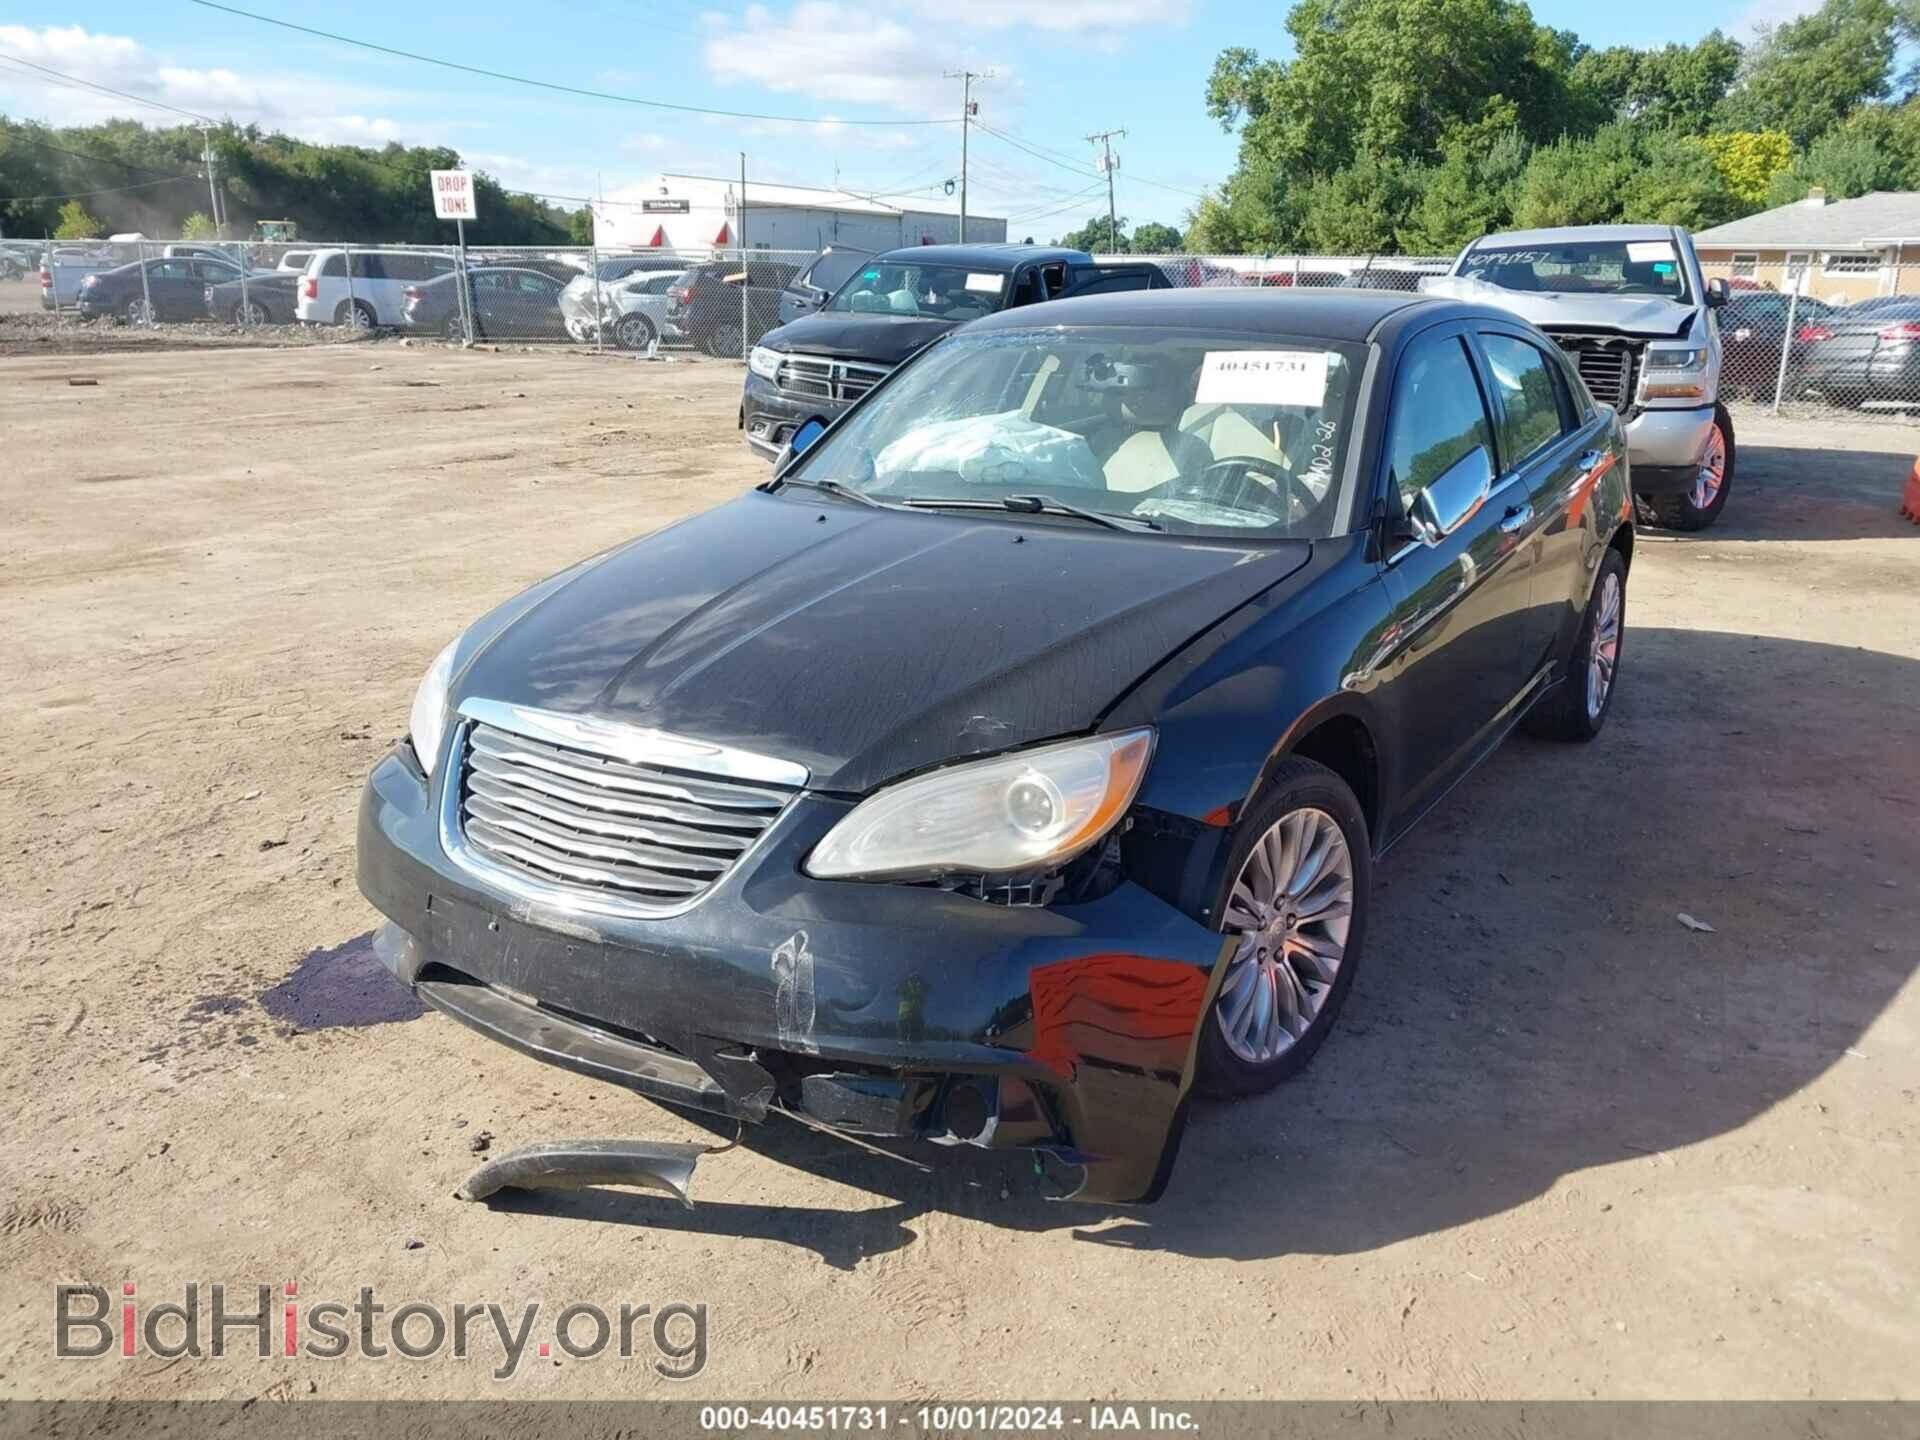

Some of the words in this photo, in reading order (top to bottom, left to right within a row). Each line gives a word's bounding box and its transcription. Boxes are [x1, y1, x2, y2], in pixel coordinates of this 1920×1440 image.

[437, 175, 467, 192] DROP
[442, 197, 468, 213] ZONE
[1216, 360, 1306, 373] 40451731
